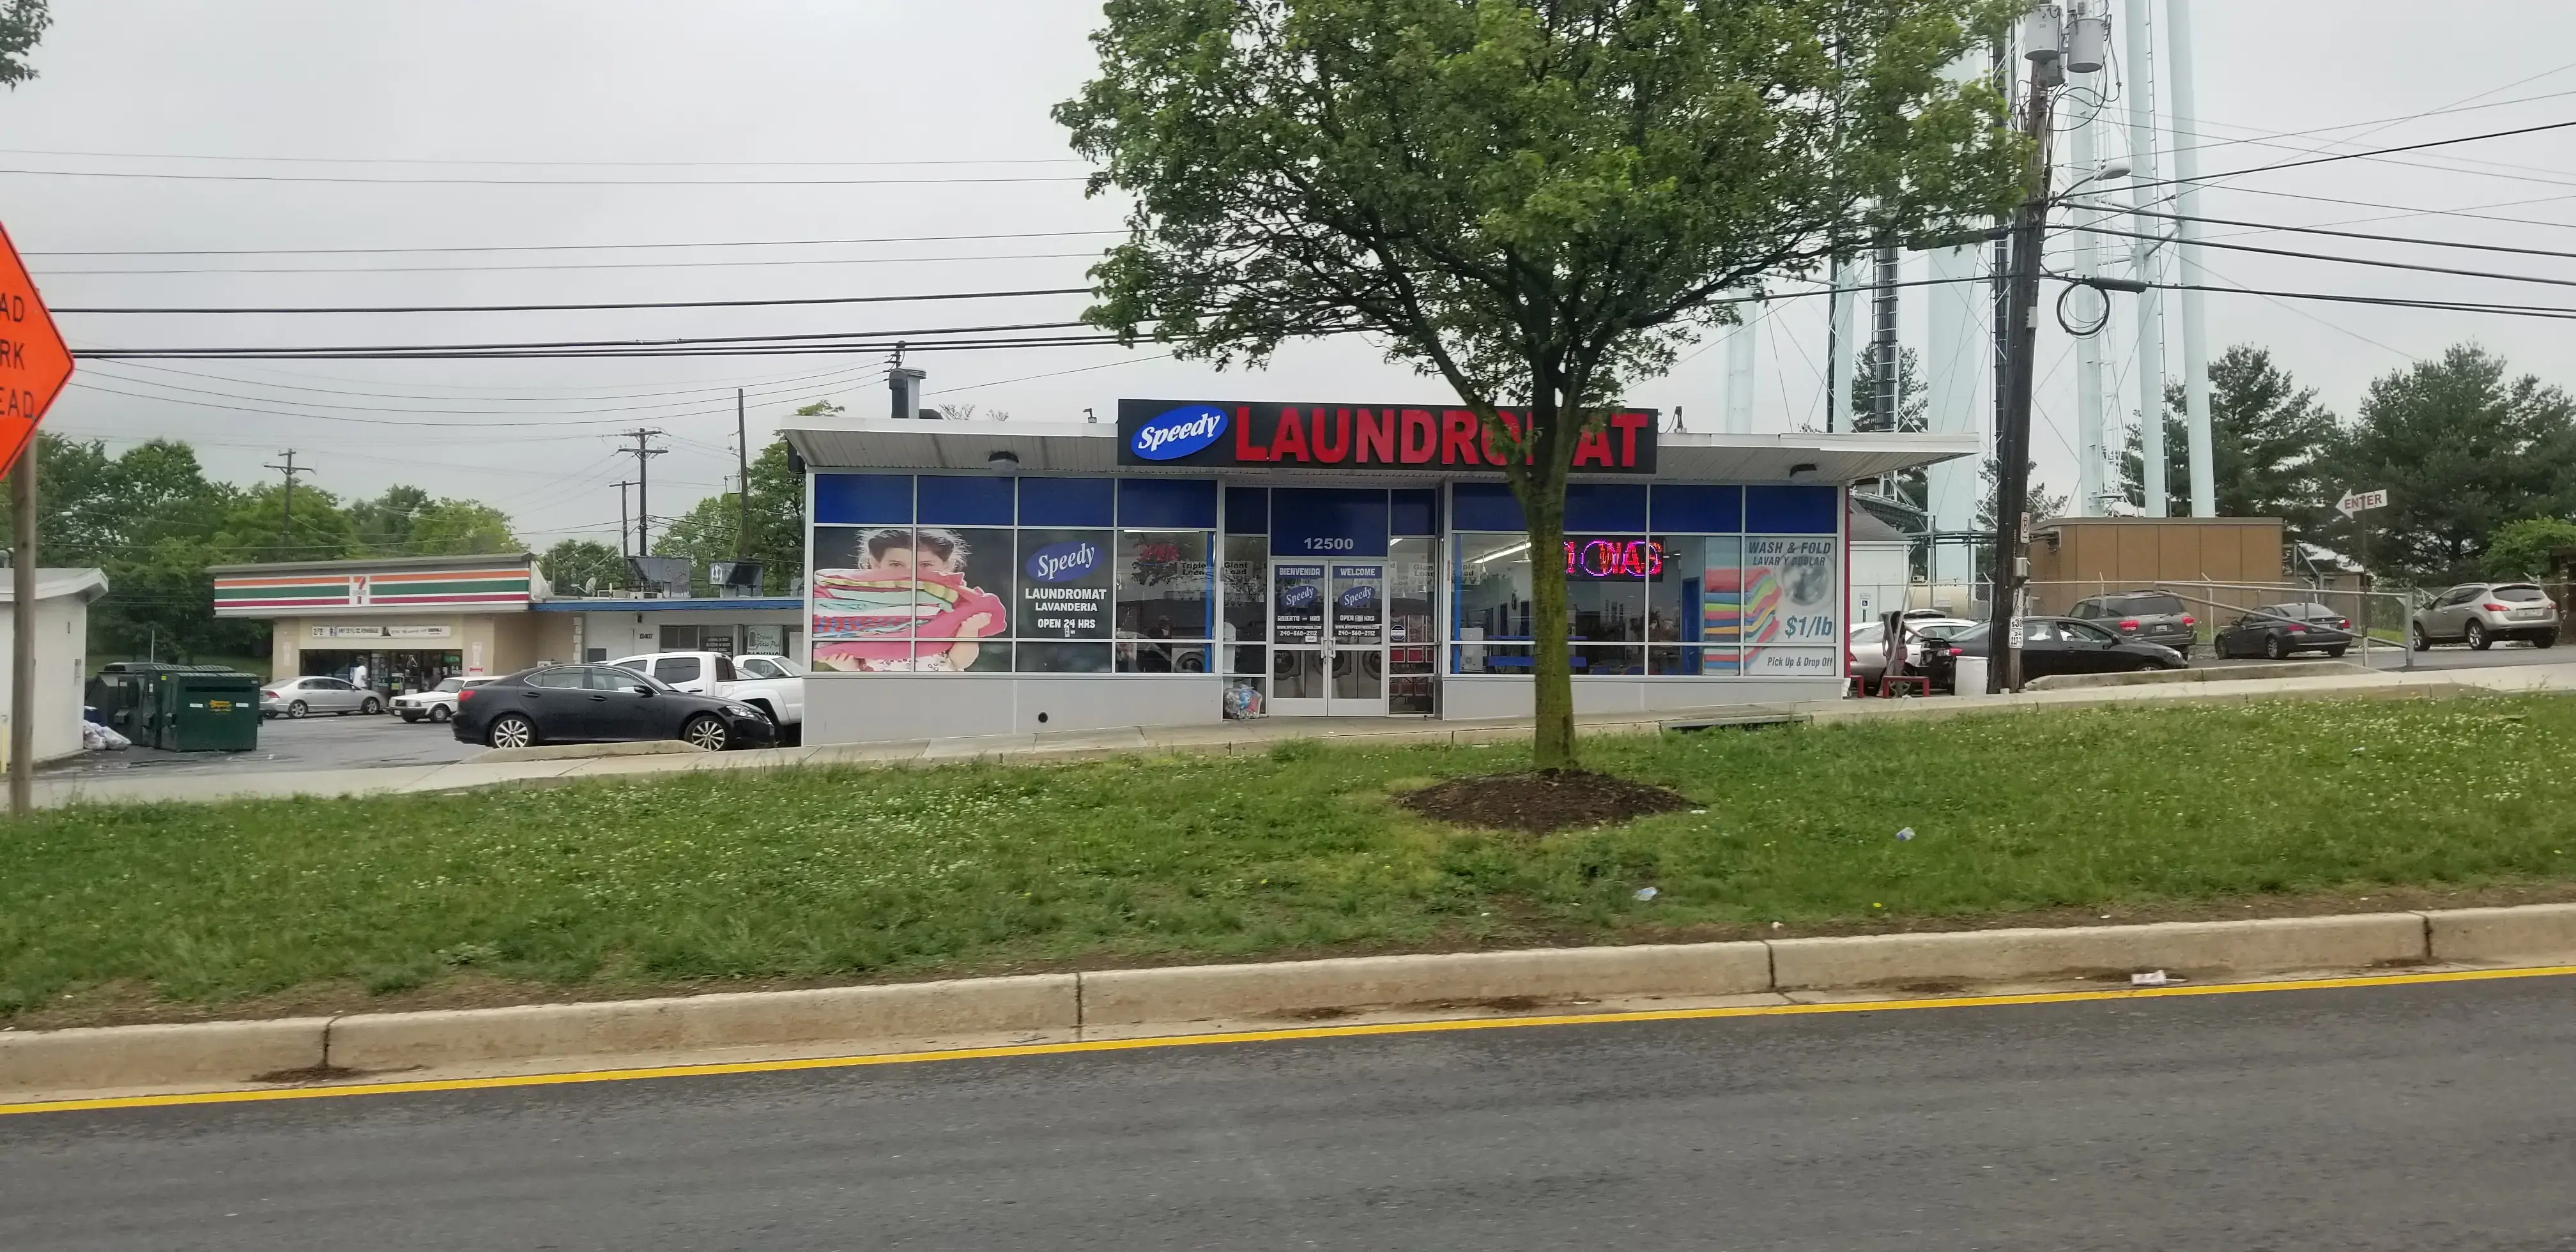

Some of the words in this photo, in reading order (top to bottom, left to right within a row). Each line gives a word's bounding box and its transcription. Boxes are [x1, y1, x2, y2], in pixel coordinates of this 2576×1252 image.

[1138, 413, 1220, 452] Speedy
[1236, 406, 1648, 468] LAUNDROAT
[2344, 494, 2382, 510] ENTER
[1304, 537, 1354, 550] 12500
[1749, 542, 1782, 554] WASH
[1787, 542, 1795, 554] &
[1801, 542, 1831, 554] FOLD
[1038, 542, 1095, 580] Speedy
[1752, 556, 1781, 565] LAVAR
[1784, 556, 1790, 566] Y
[1279, 567, 1321, 576] BIENVENIDA
[1340, 567, 1376, 576] WELCOME
[1025, 588, 1107, 600] LAUNDROMAT
[1286, 586, 1314, 606] Speedy
[1344, 586, 1372, 606] Speedy
[1035, 602, 1098, 611] LAVANDERIA
[1038, 618, 1061, 629] OPEN
[1063, 618, 1076, 629] 24
[1078, 619, 1096, 629] HRS
[1784, 615, 1833, 639] $1/lb
[1767, 657, 1783, 666] Pick
[1785, 657, 1795, 668] Up
[1796, 657, 1802, 666] &
[1804, 657, 1820, 669] Drop
[1821, 657, 1833, 667] Off
